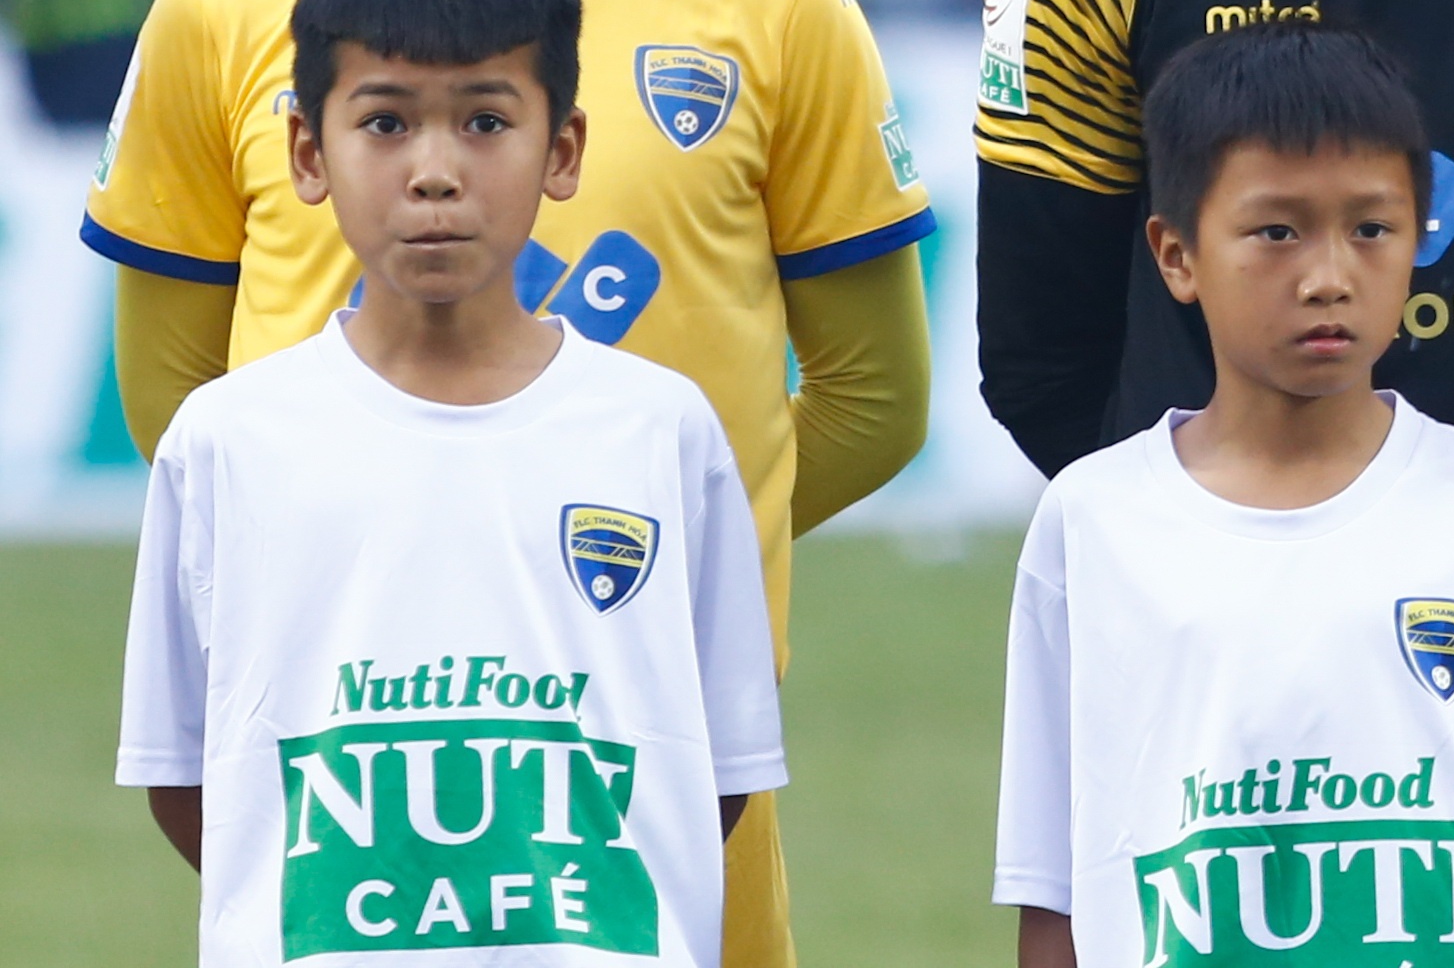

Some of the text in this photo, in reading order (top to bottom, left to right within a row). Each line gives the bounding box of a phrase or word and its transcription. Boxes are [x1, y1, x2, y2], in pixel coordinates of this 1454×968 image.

[672, 56, 706, 68] THANH
[982, 53, 1020, 90] UTI
[593, 517, 626, 529] THANH
[287, 737, 638, 859] NUTI
[1180, 756, 1436, 831] NutiFood
[345, 862, 590, 937] CAFÉ
